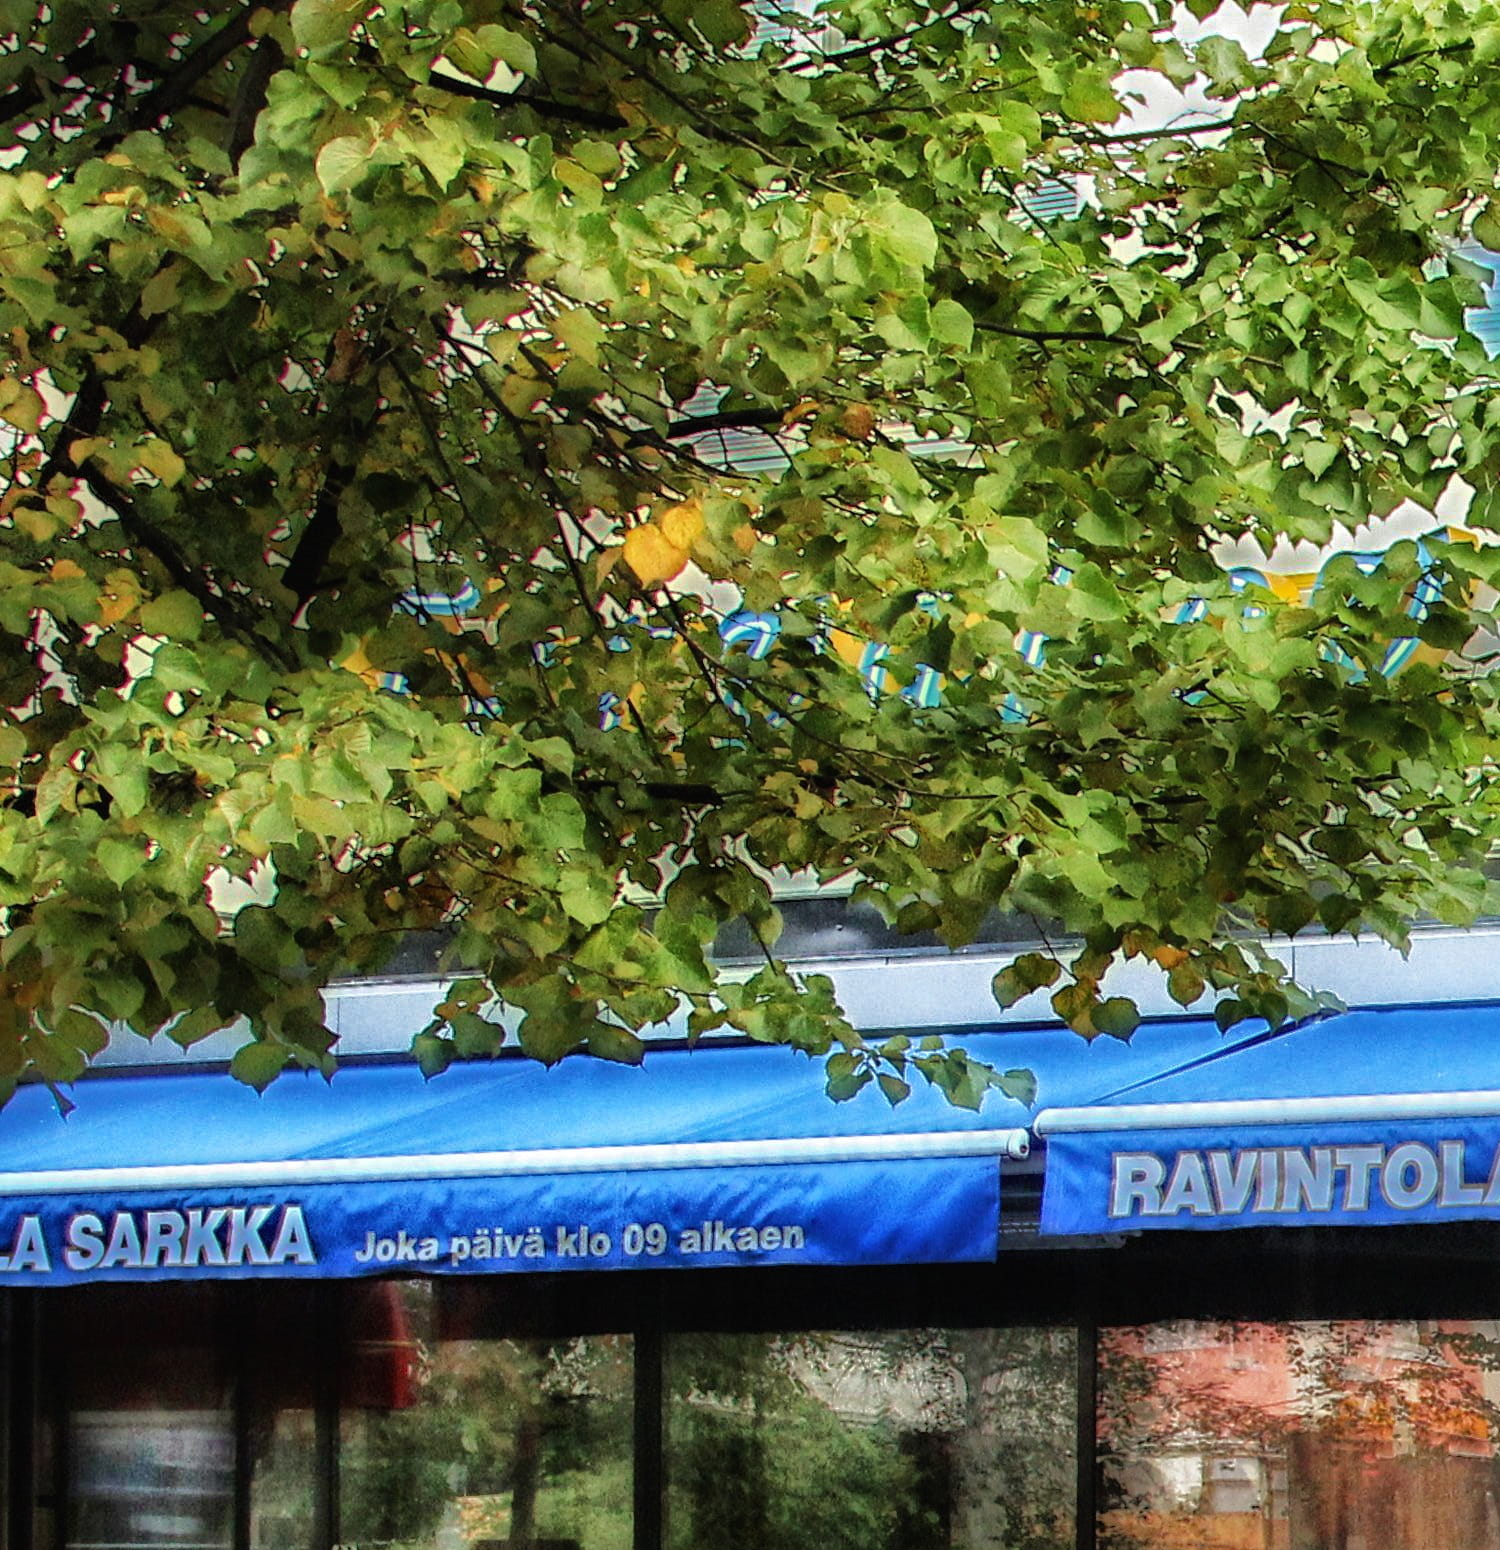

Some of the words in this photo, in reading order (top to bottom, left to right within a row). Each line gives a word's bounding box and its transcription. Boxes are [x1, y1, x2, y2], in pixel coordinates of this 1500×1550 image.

[65, 1204, 317, 1270] SARKKA
[355, 1231, 439, 1263] Joka
[451, 1228, 545, 1266] päivä
[556, 1226, 611, 1257] klo
[623, 1223, 667, 1255] 09
[680, 1221, 806, 1253] alkaen
